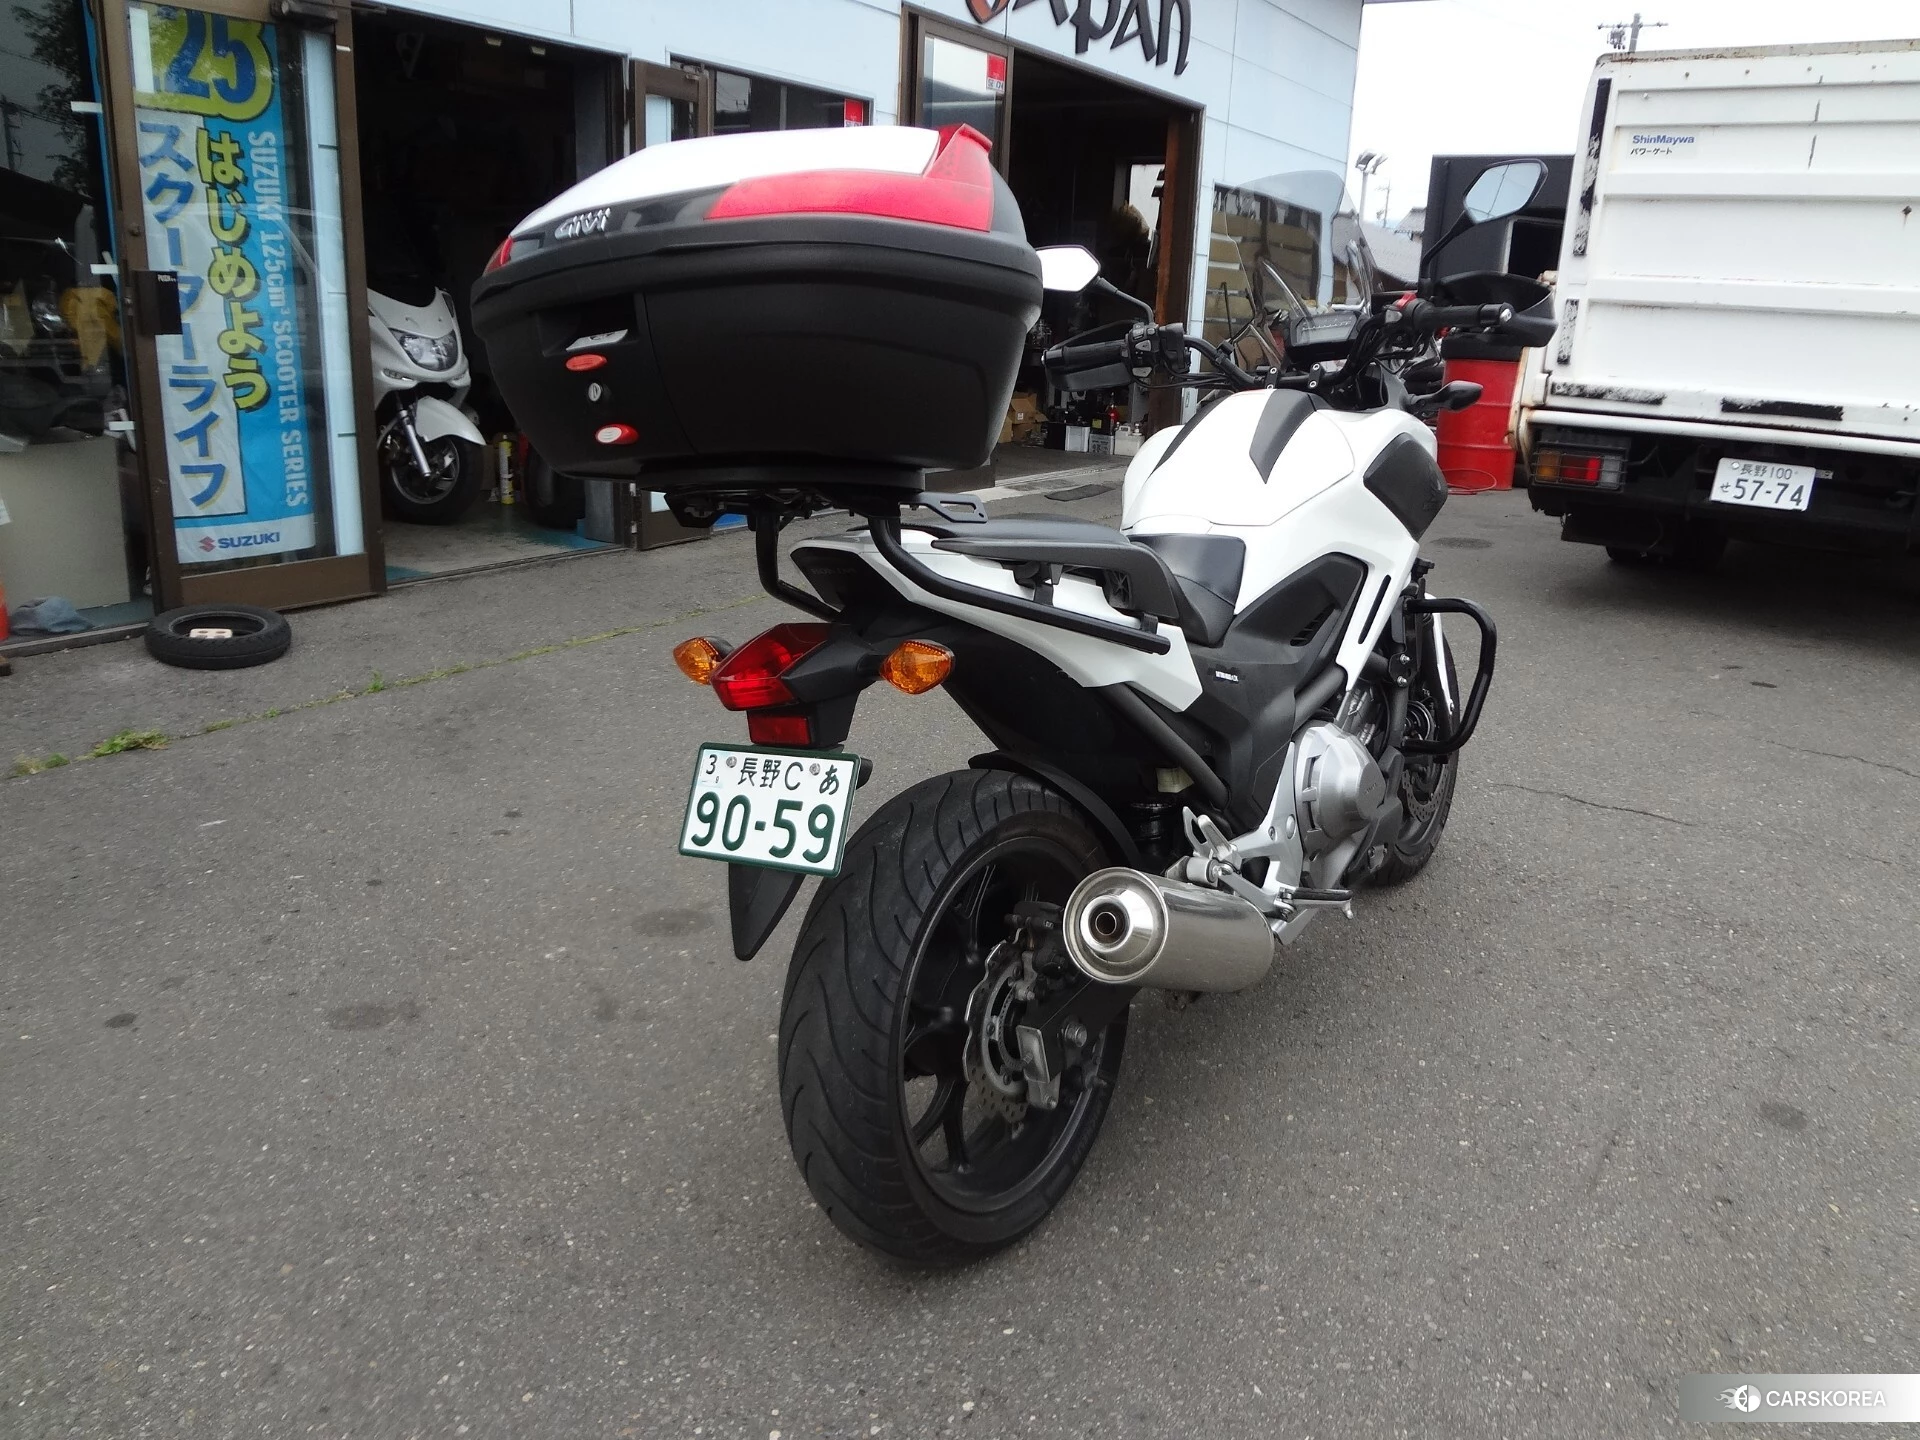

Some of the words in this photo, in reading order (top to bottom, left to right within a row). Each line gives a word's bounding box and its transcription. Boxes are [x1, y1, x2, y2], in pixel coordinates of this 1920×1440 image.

[1630, 147, 1673, 156] パワーゲート
[1632, 134, 1695, 146] ShinMaywa
[248, 131, 284, 221] SUZUKI
[196, 127, 269, 412] はじめよう
[139, 120, 227, 508] スクーターライフ
[273, 320, 300, 424] SCOOTER
[281, 429, 308, 507] SERIES
[1733, 478, 1805, 506] 57-74
[217, 531, 281, 550] SUZUKI
[705, 754, 718, 775] 3
[819, 764, 840, 796] あ
[691, 791, 836, 863] 90-59
